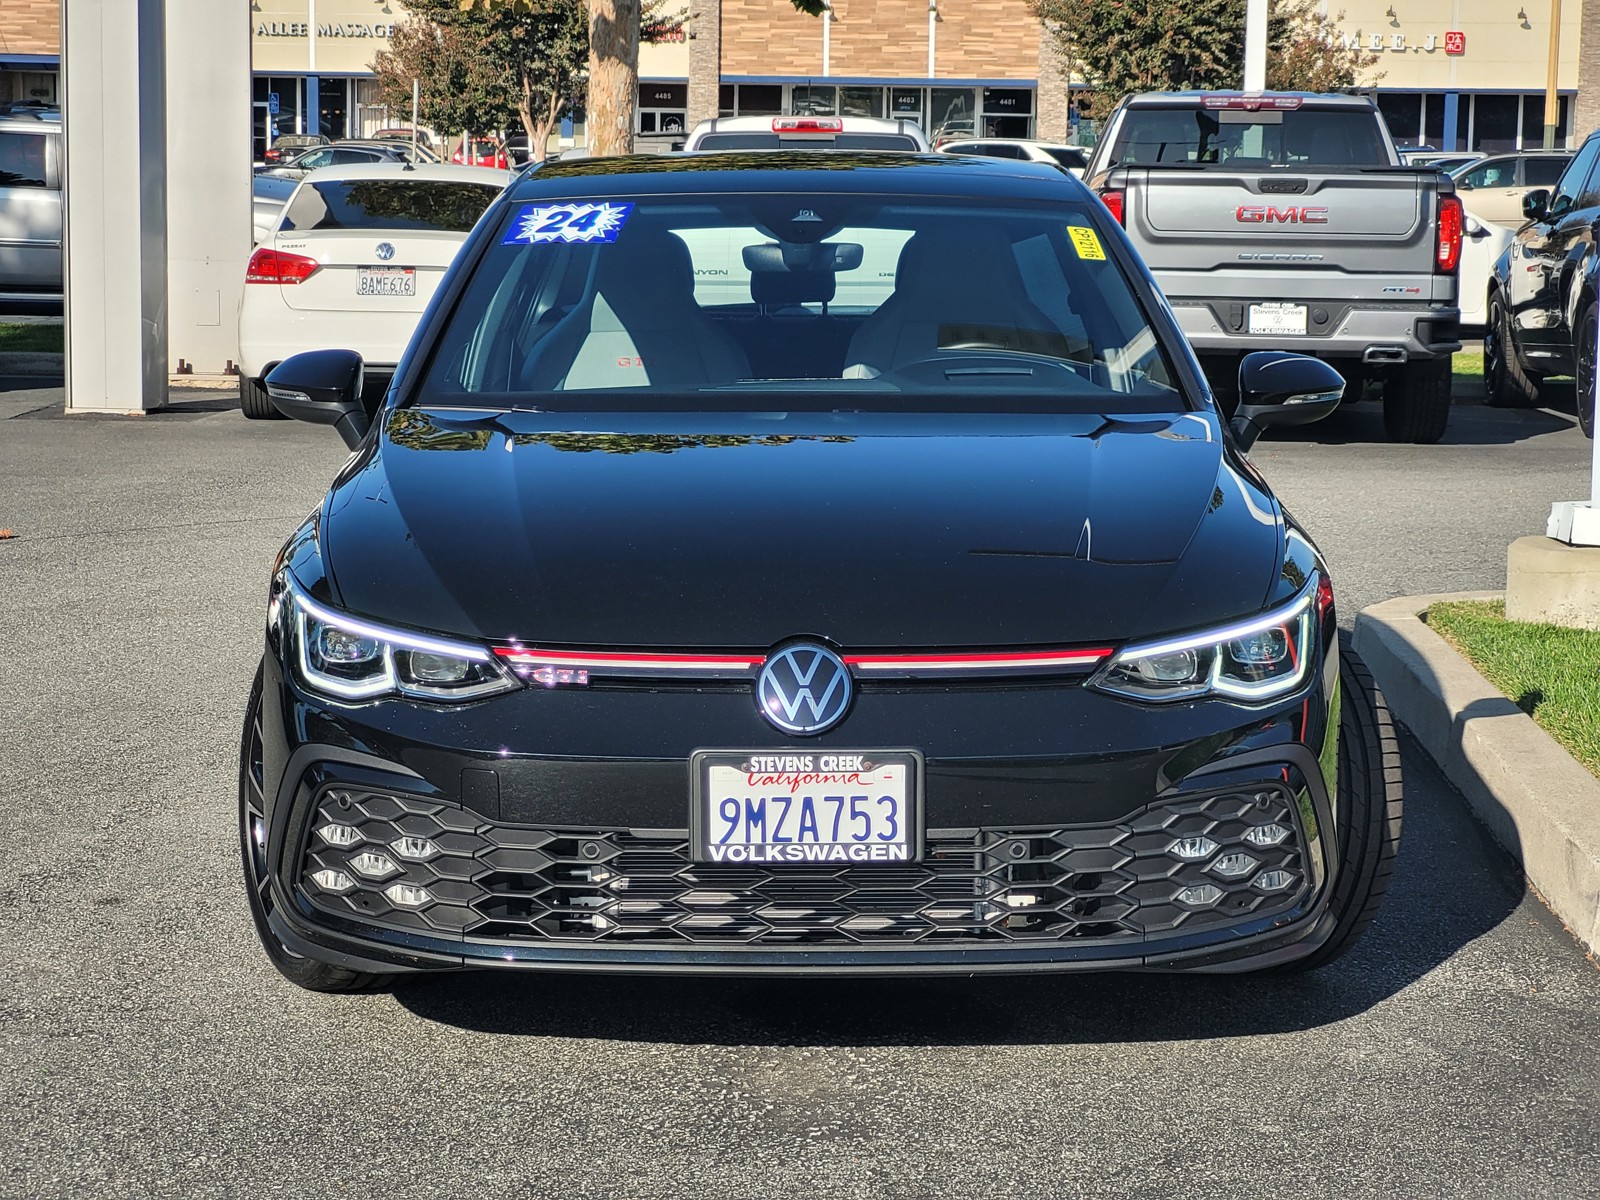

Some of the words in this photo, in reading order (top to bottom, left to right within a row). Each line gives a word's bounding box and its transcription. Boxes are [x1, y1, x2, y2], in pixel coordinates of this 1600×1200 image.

[252, 22, 308, 37] ALLEE
[318, 22, 394, 37] MASSAGE
[535, 210, 602, 233] 24
[1236, 205, 1328, 224] GMC
[1073, 228, 1099, 258] CP12116
[361, 277, 411, 291] 8AMF676
[534, 668, 588, 684] GTI
[750, 756, 813, 772] STEVENS
[820, 755, 864, 772] CREEK
[747, 772, 874, 793] California
[719, 796, 898, 844] 9MZA753
[708, 844, 908, 861] VOLKSWAGEN
